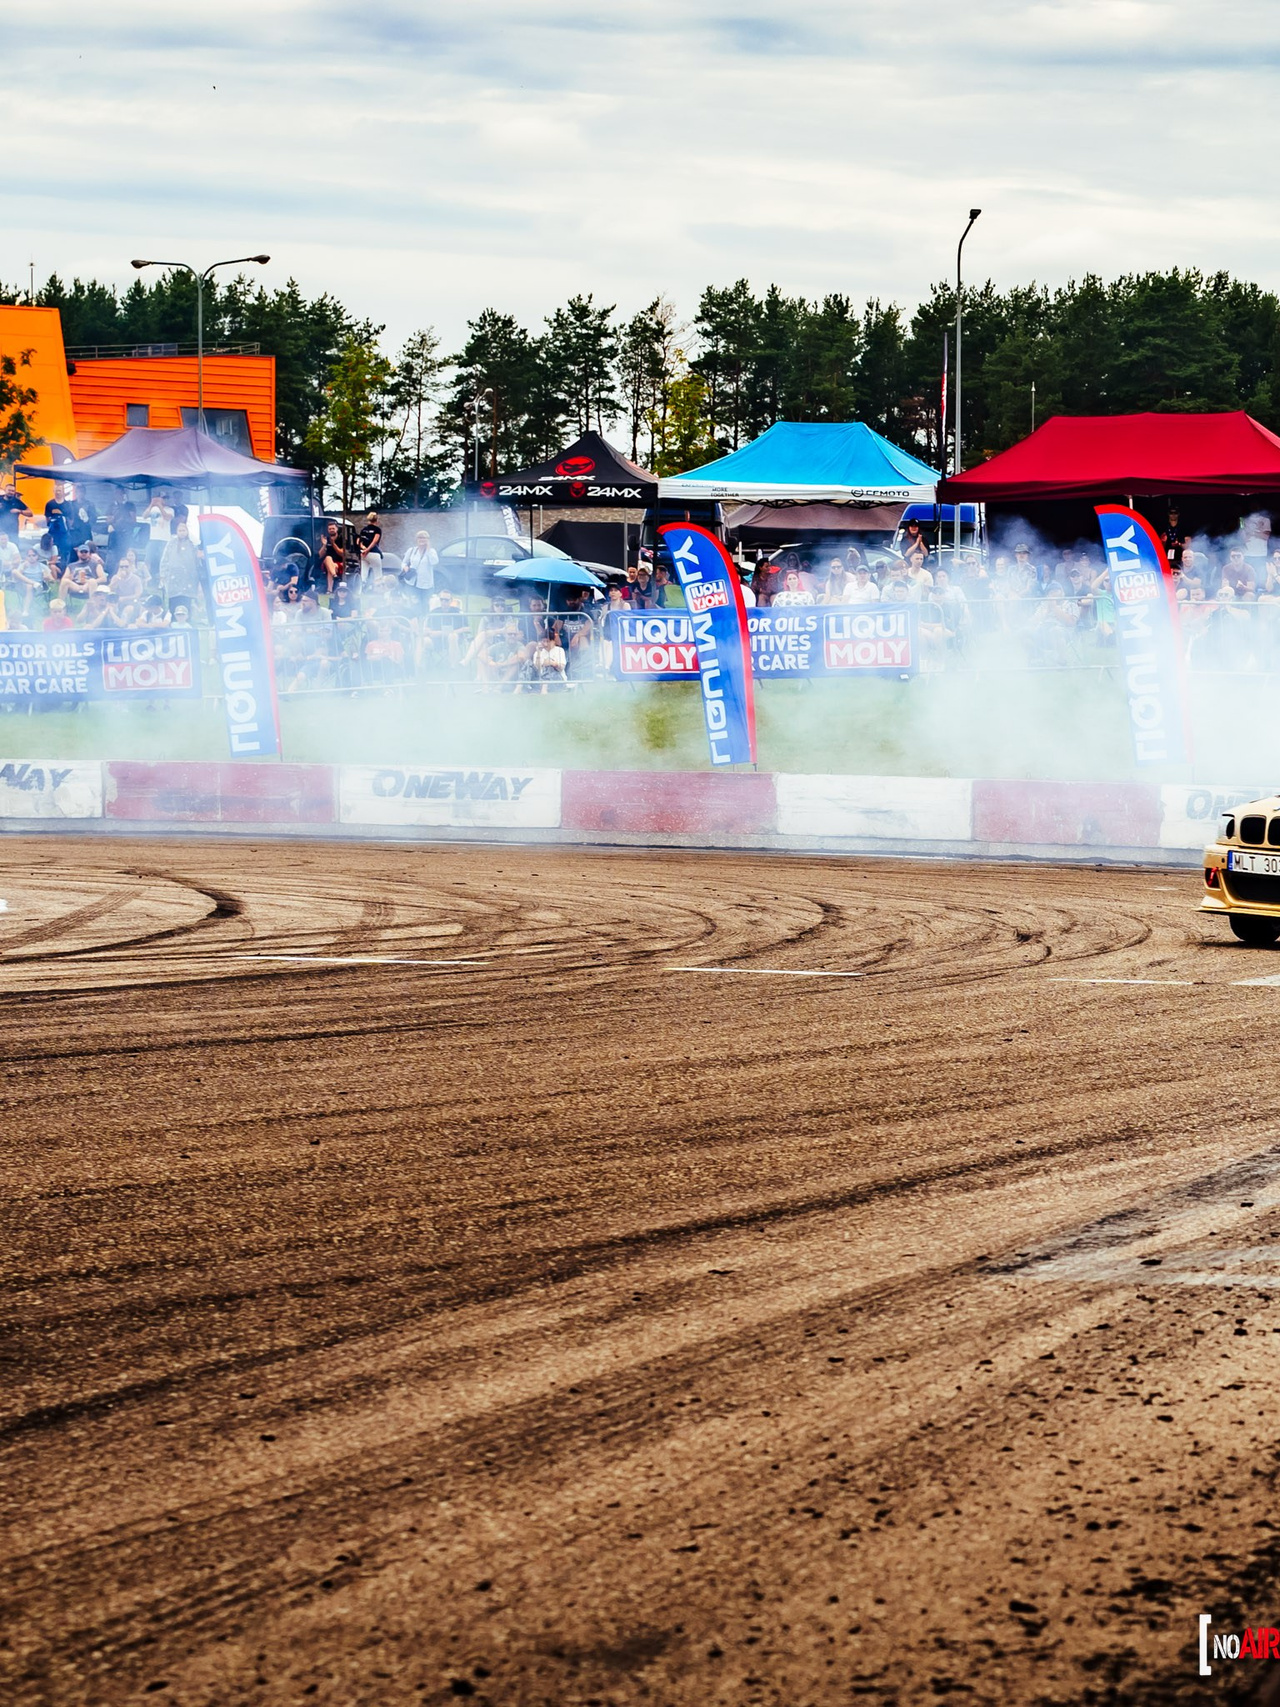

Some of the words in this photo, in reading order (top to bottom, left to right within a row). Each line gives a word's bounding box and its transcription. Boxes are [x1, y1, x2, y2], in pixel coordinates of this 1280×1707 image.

[499, 485, 553, 496] 24MX
[587, 486, 642, 498] 24MX
[776, 616, 817, 632] OILS
[828, 613, 906, 640] LIQUI
[0, 643, 47, 659] OTOR
[52, 642, 95, 658] OILS
[107, 635, 186, 663] LIQUI
[750, 634, 811, 652] ITIVES
[626, 646, 698, 671] MOLY
[831, 640, 909, 666] MOLY
[0, 660, 89, 677] DDITIVES
[758, 654, 810, 670] CARE
[108, 662, 189, 688] MOLY
[0, 678, 31, 695] AR
[35, 678, 88, 694] CARE
